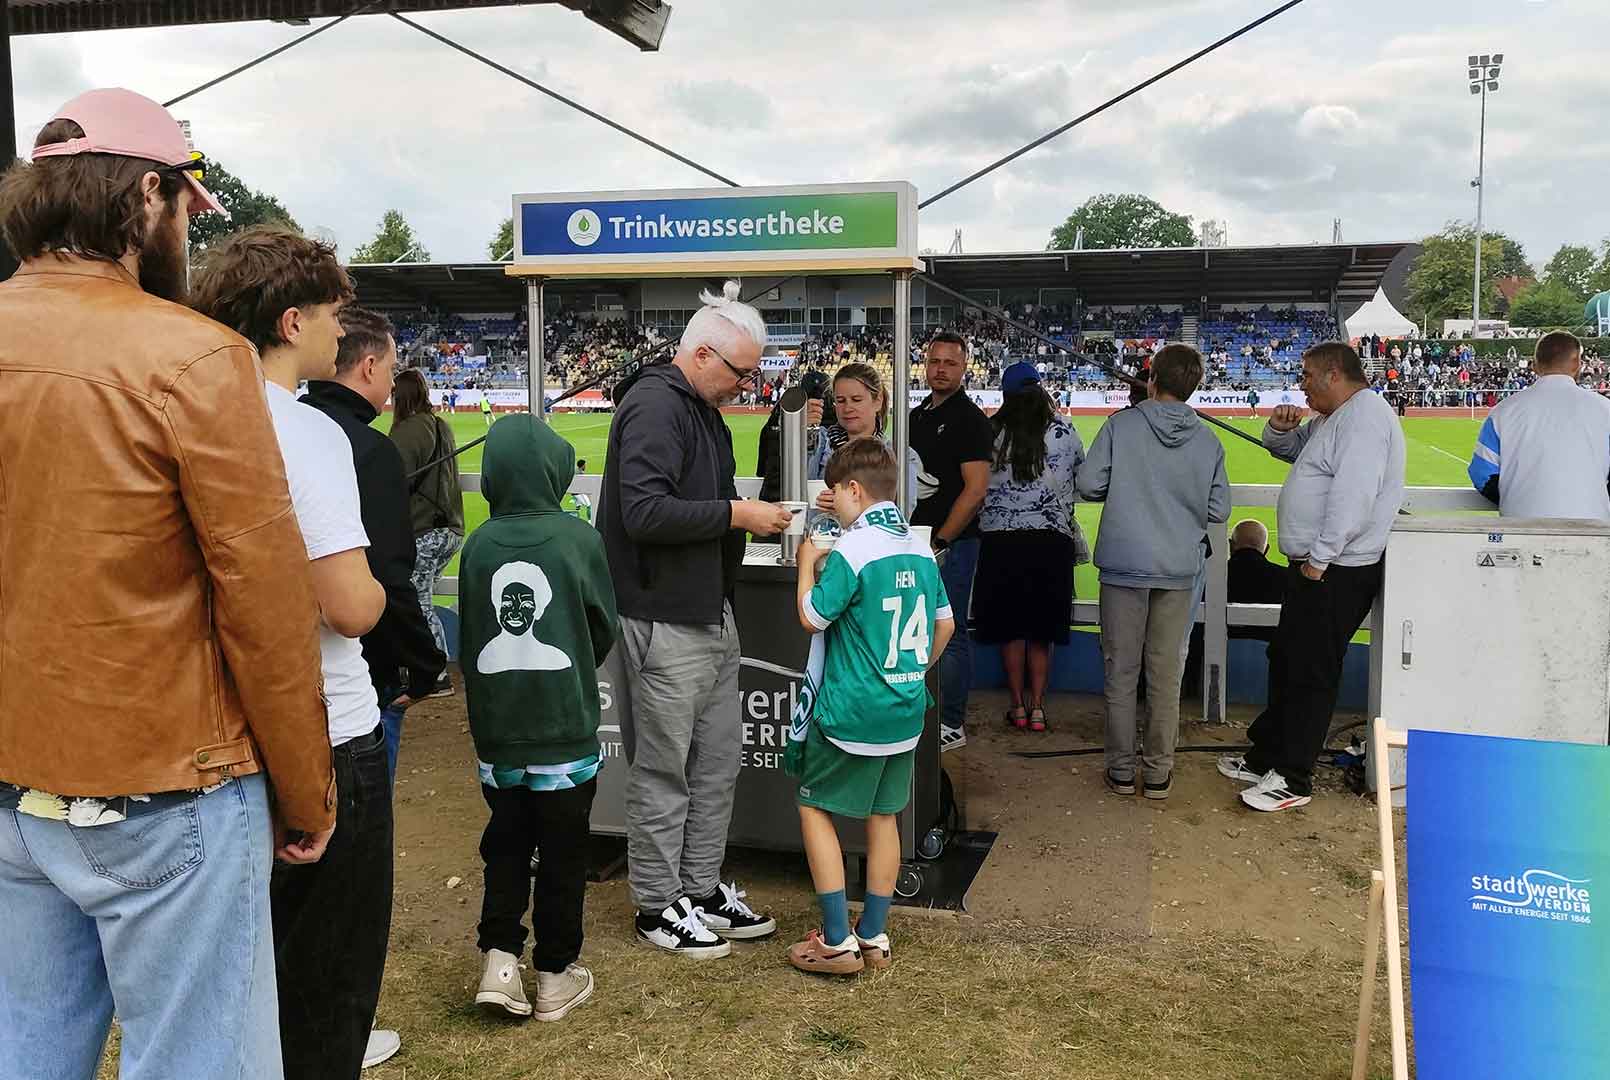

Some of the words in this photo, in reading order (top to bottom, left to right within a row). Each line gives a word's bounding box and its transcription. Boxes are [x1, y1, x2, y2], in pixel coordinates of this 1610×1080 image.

[609, 209, 845, 239] Trinkwassertheke
[882, 594, 929, 669] 74
[1471, 875, 1525, 896] stadt
[1531, 882, 1590, 902] werke
[1472, 902, 1488, 911] MIT
[1488, 903, 1514, 914] ALLER
[1514, 907, 1549, 919] ENERGIE
[1550, 912, 1569, 921] SEIT
[1534, 898, 1591, 914] VERDEN
